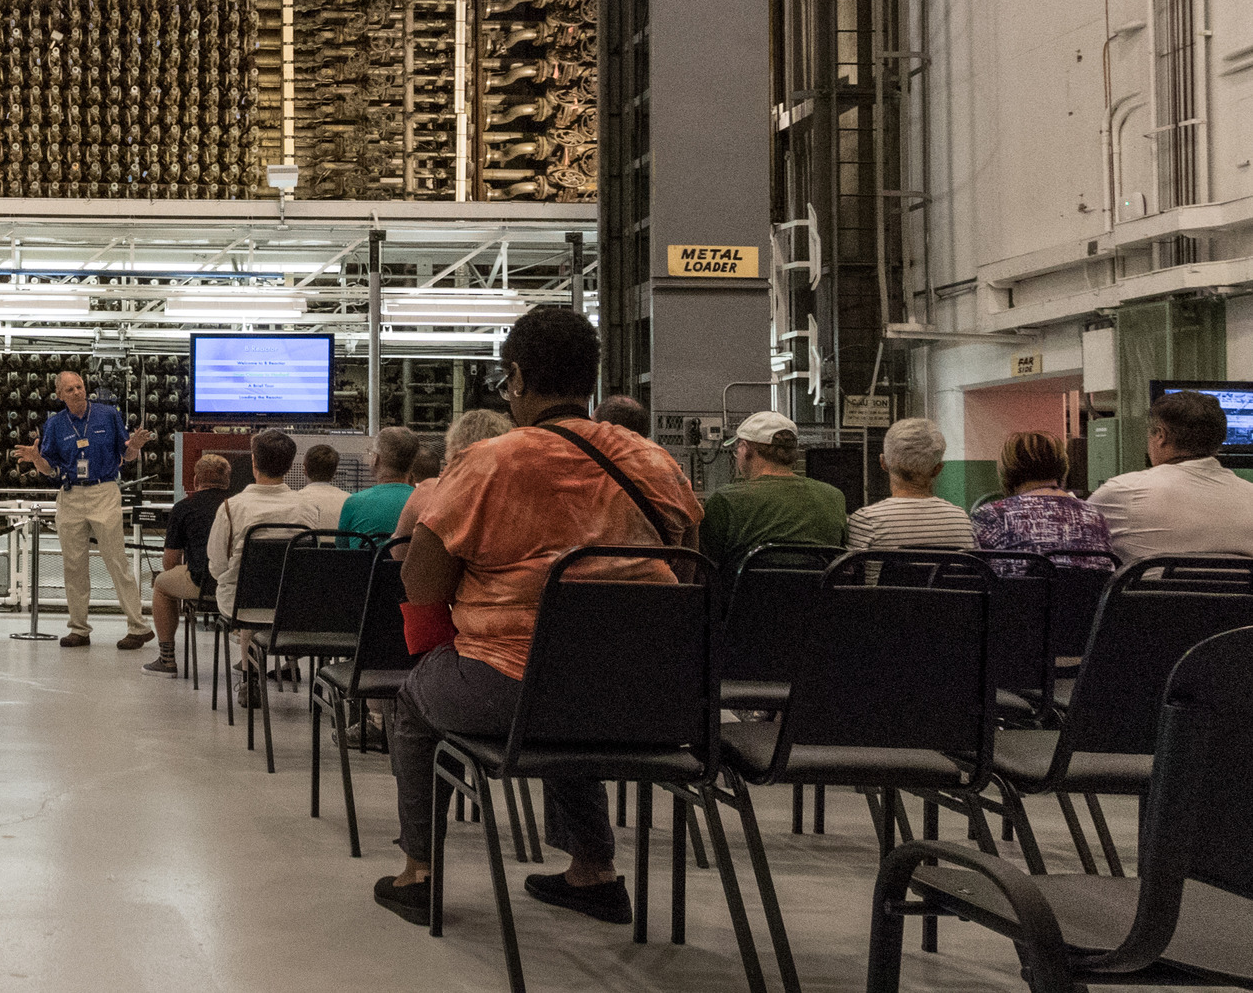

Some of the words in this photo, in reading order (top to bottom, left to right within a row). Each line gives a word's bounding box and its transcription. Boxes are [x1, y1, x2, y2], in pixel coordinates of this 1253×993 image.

[681, 248, 743, 261] METAL
[684, 261, 738, 273] LOADER
[251, 345, 279, 353] Reactor
[1017, 356, 1034, 367] FAR
[851, 398, 888, 407] CAUION
